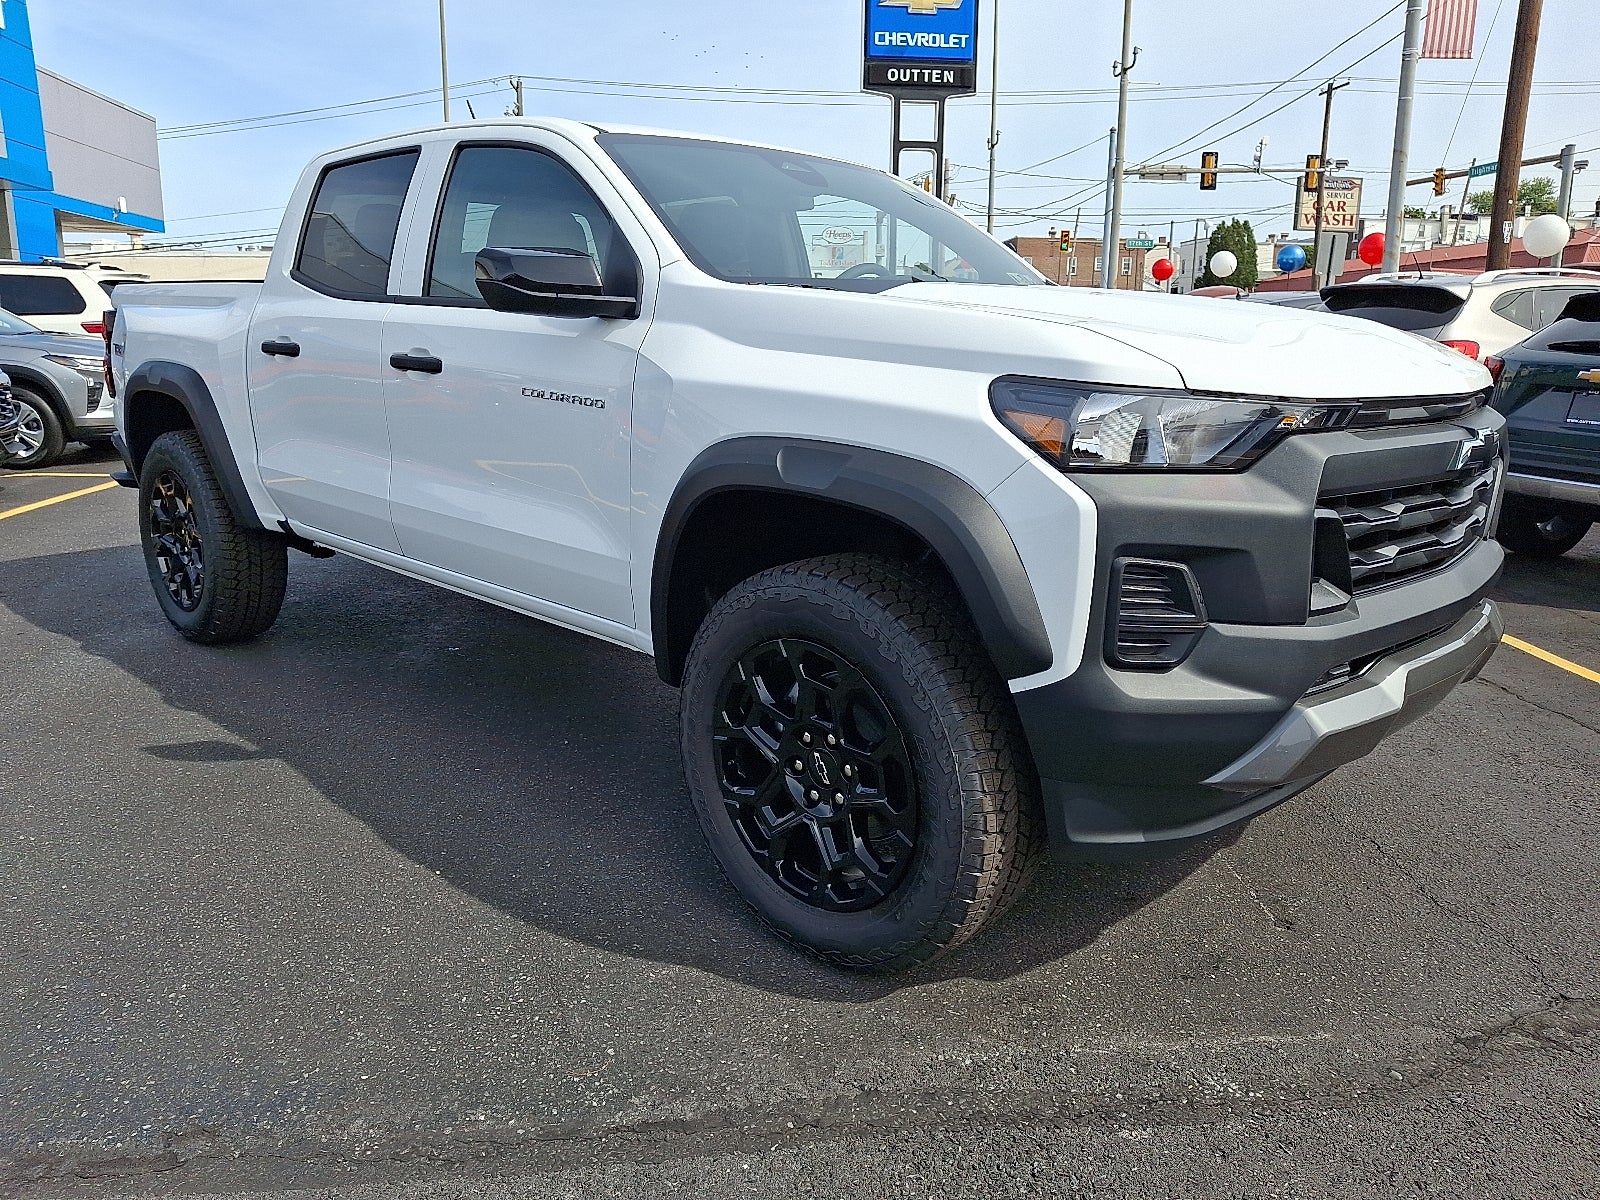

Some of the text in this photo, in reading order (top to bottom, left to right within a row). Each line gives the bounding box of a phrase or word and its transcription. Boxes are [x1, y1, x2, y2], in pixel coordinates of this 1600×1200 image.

[874, 31, 969, 48] CHEVROLET
[887, 68, 954, 83] OUTTEN
[1326, 191, 1355, 200] SERVICE
[521, 387, 606, 409] COLORADO
